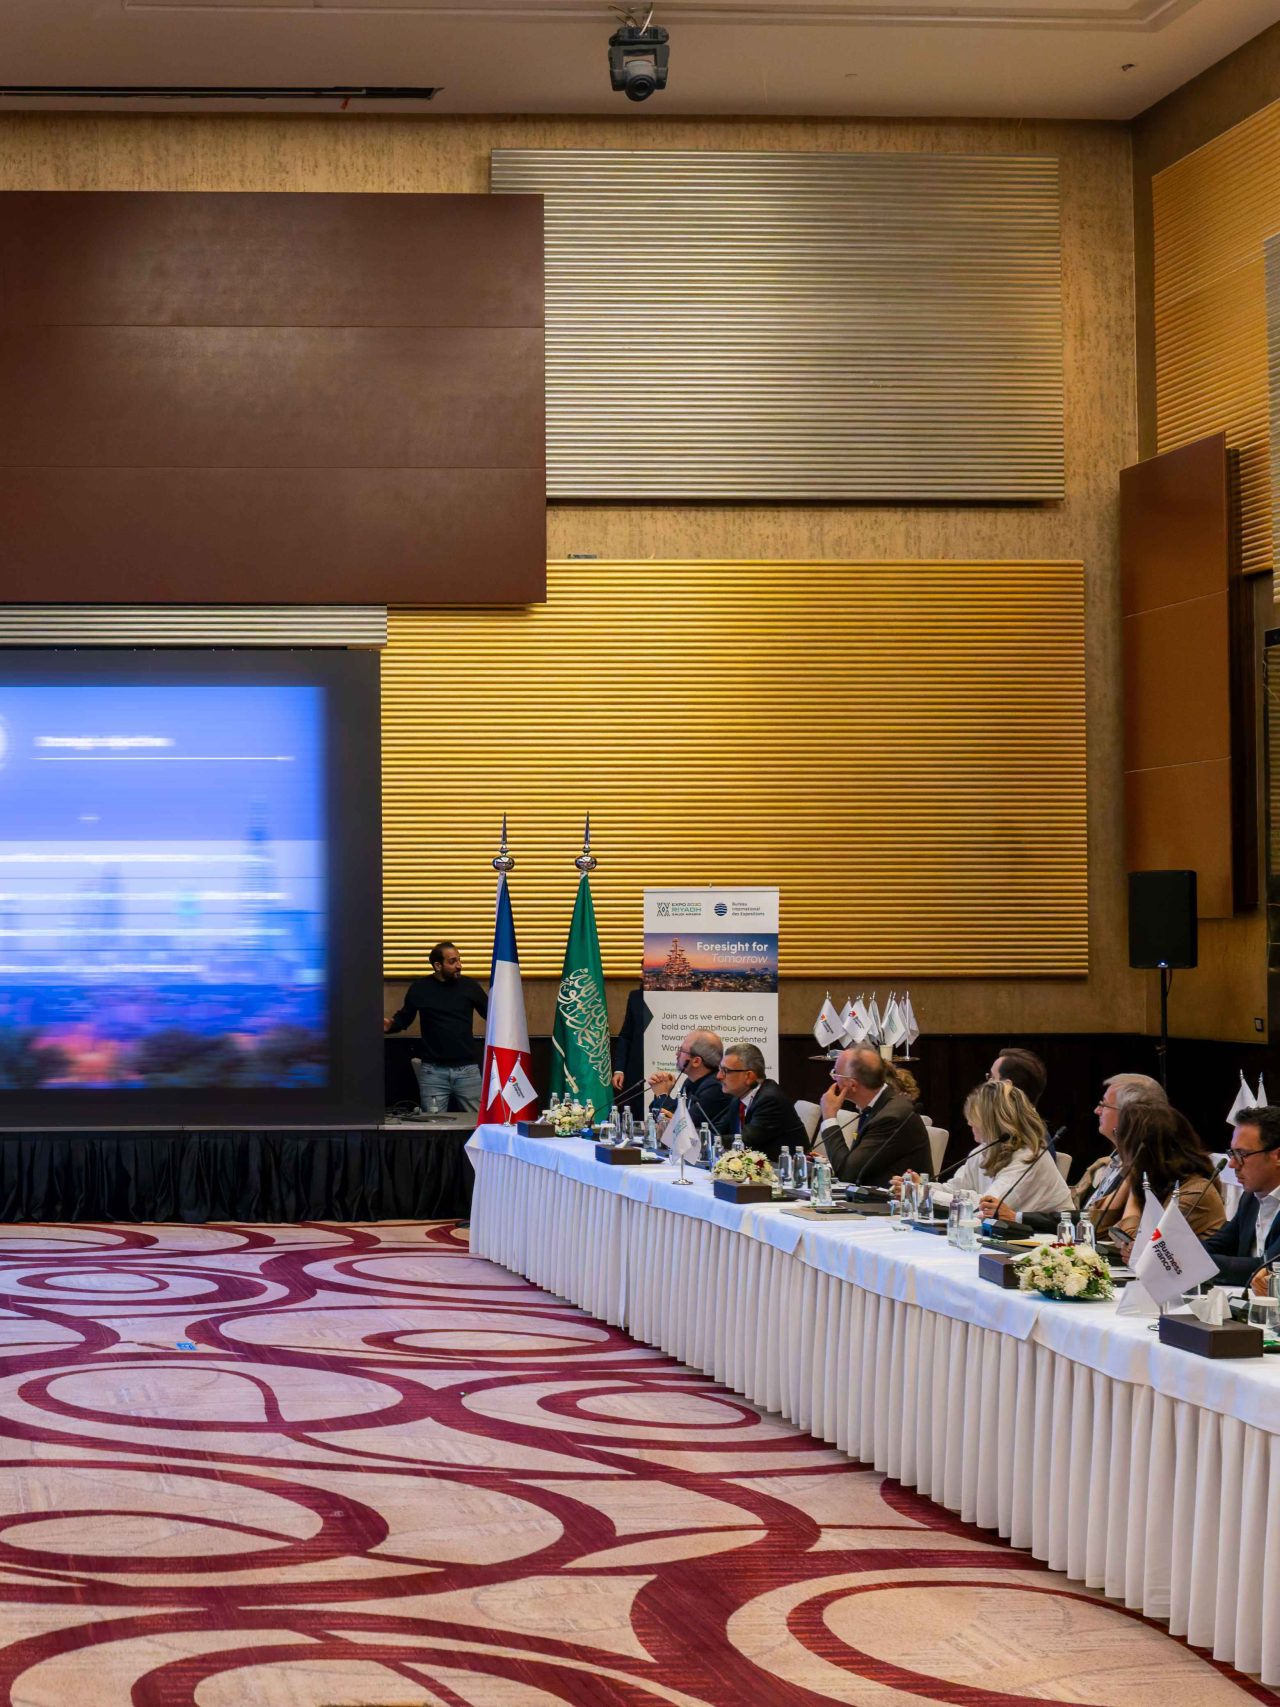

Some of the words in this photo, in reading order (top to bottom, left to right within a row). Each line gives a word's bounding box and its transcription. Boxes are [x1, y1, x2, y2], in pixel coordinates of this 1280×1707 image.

[696, 941, 750, 954] Foresight
[752, 941, 769, 952] for
[711, 953, 768, 964] Tomorrow
[661, 1012, 677, 1020] Join
[714, 1013, 745, 1021] embark
[661, 1023, 679, 1031] bold
[680, 1023, 696, 1031] and
[697, 1024, 737, 1032] ambitious
[738, 1025, 768, 1034] journey
[1152, 1244, 1172, 1271] France
[1158, 1240, 1183, 1275] Business
